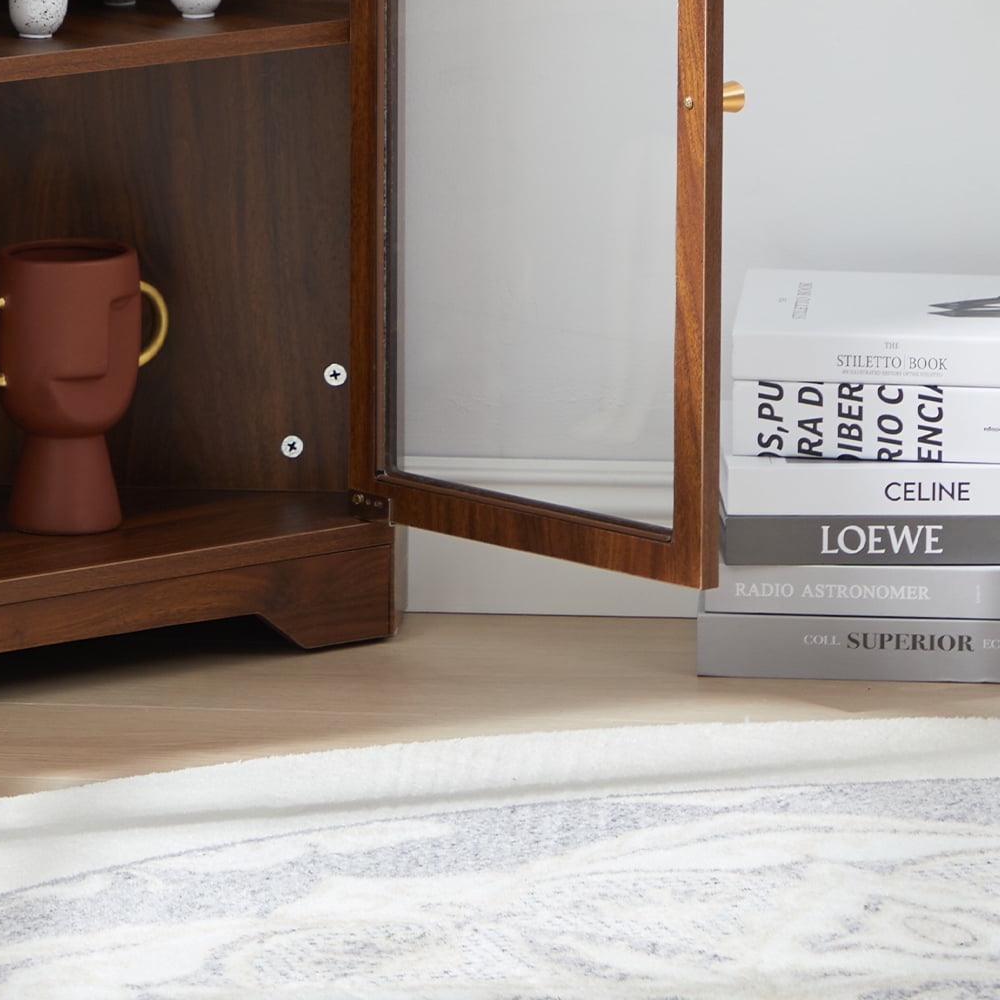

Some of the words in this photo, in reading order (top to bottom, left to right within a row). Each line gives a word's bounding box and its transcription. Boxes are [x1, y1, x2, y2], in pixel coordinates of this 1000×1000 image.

[884, 341, 899, 350] THE
[836, 353, 902, 369] STILETTO
[908, 356, 948, 370] BOOK
[837, 382, 864, 460] IBER
[884, 481, 971, 502] CELINE
[820, 524, 944, 554] LOEWE
[735, 582, 794, 598] RADIO
[801, 583, 931, 600] ASTRONOMER
[803, 634, 841, 647] COLL
[846, 631, 975, 653] SUPERIOR
